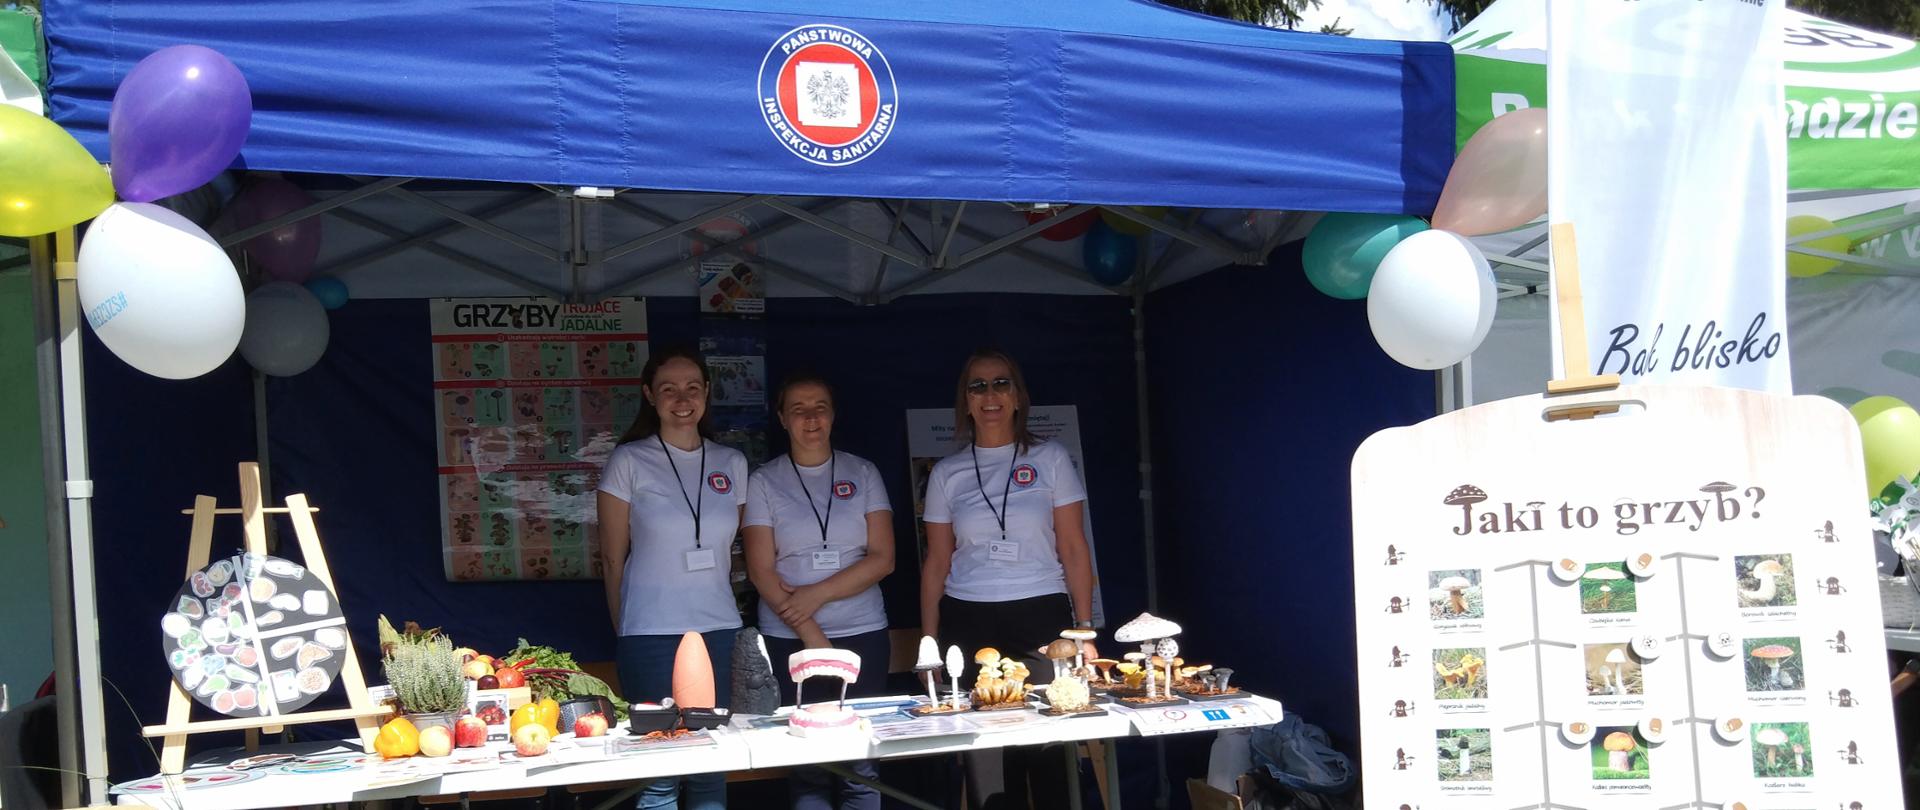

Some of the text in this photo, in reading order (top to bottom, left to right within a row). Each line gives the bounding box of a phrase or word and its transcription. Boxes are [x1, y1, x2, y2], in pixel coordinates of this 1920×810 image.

[781, 29, 873, 59] PAŃSTWOWA
[764, 97, 893, 161] INSPEKCJA SANITARNA
[453, 304, 560, 330] GRZYBY
[559, 318, 622, 332] JADALNE
[1671, 312, 1781, 373] blisko
[1444, 484, 1547, 535] Jaki
[1558, 501, 1599, 529] to
